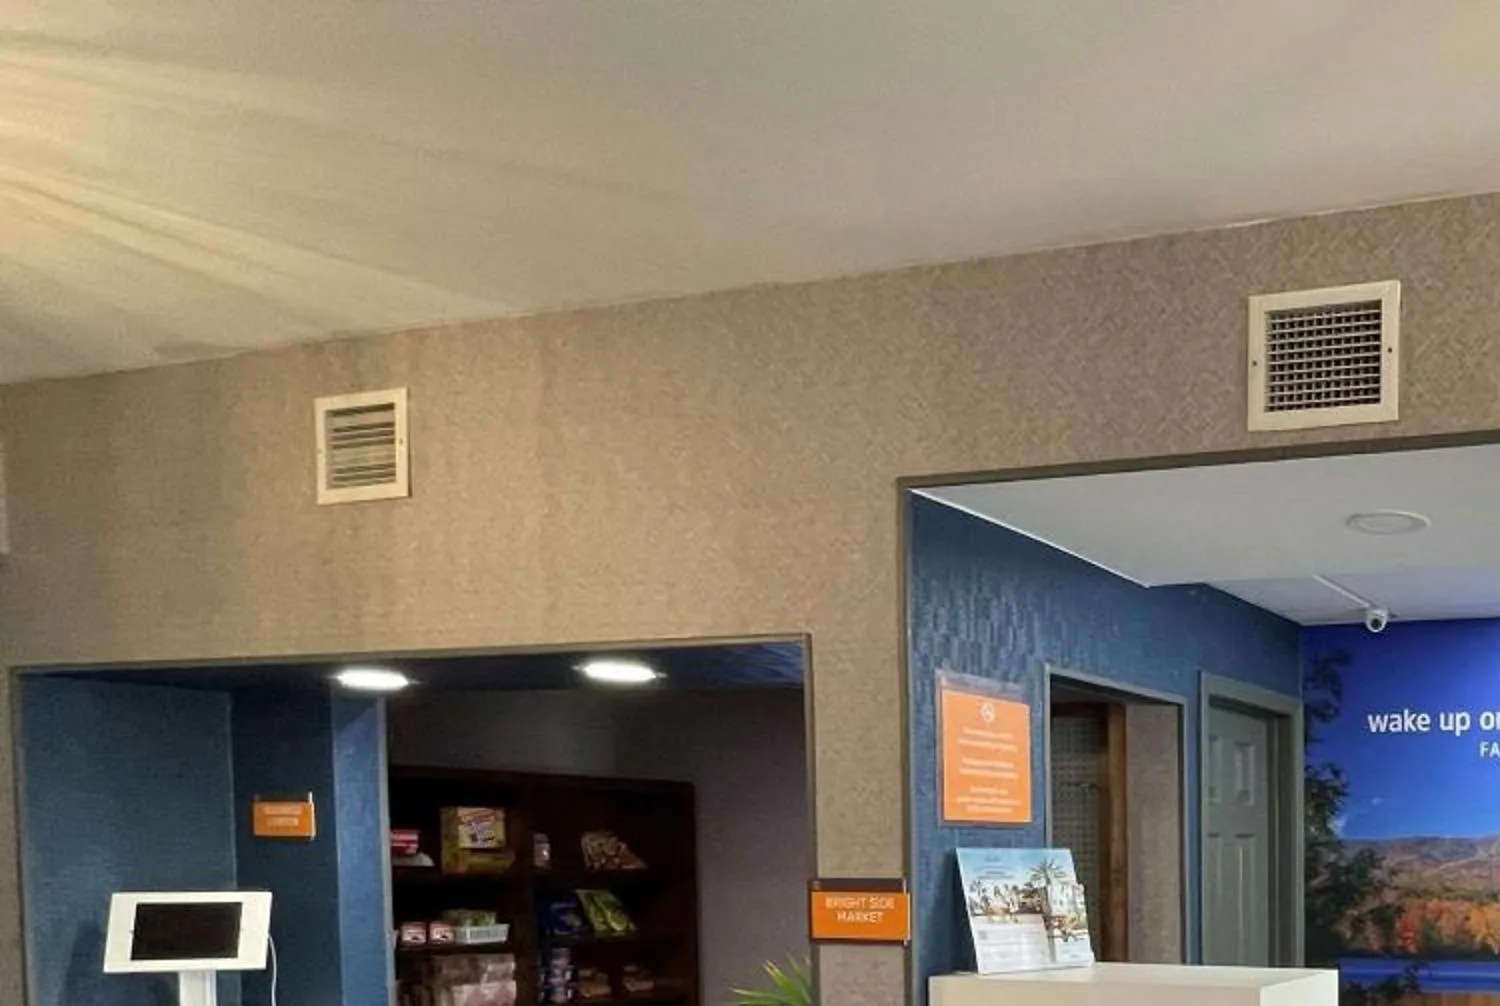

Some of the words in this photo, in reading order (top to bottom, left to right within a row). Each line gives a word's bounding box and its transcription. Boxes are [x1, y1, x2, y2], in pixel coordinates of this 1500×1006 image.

[1367, 708, 1431, 733] wake
[1439, 711, 1470, 737] up
[825, 896, 868, 910] BRIGHT
[837, 910, 884, 923] MARKET
